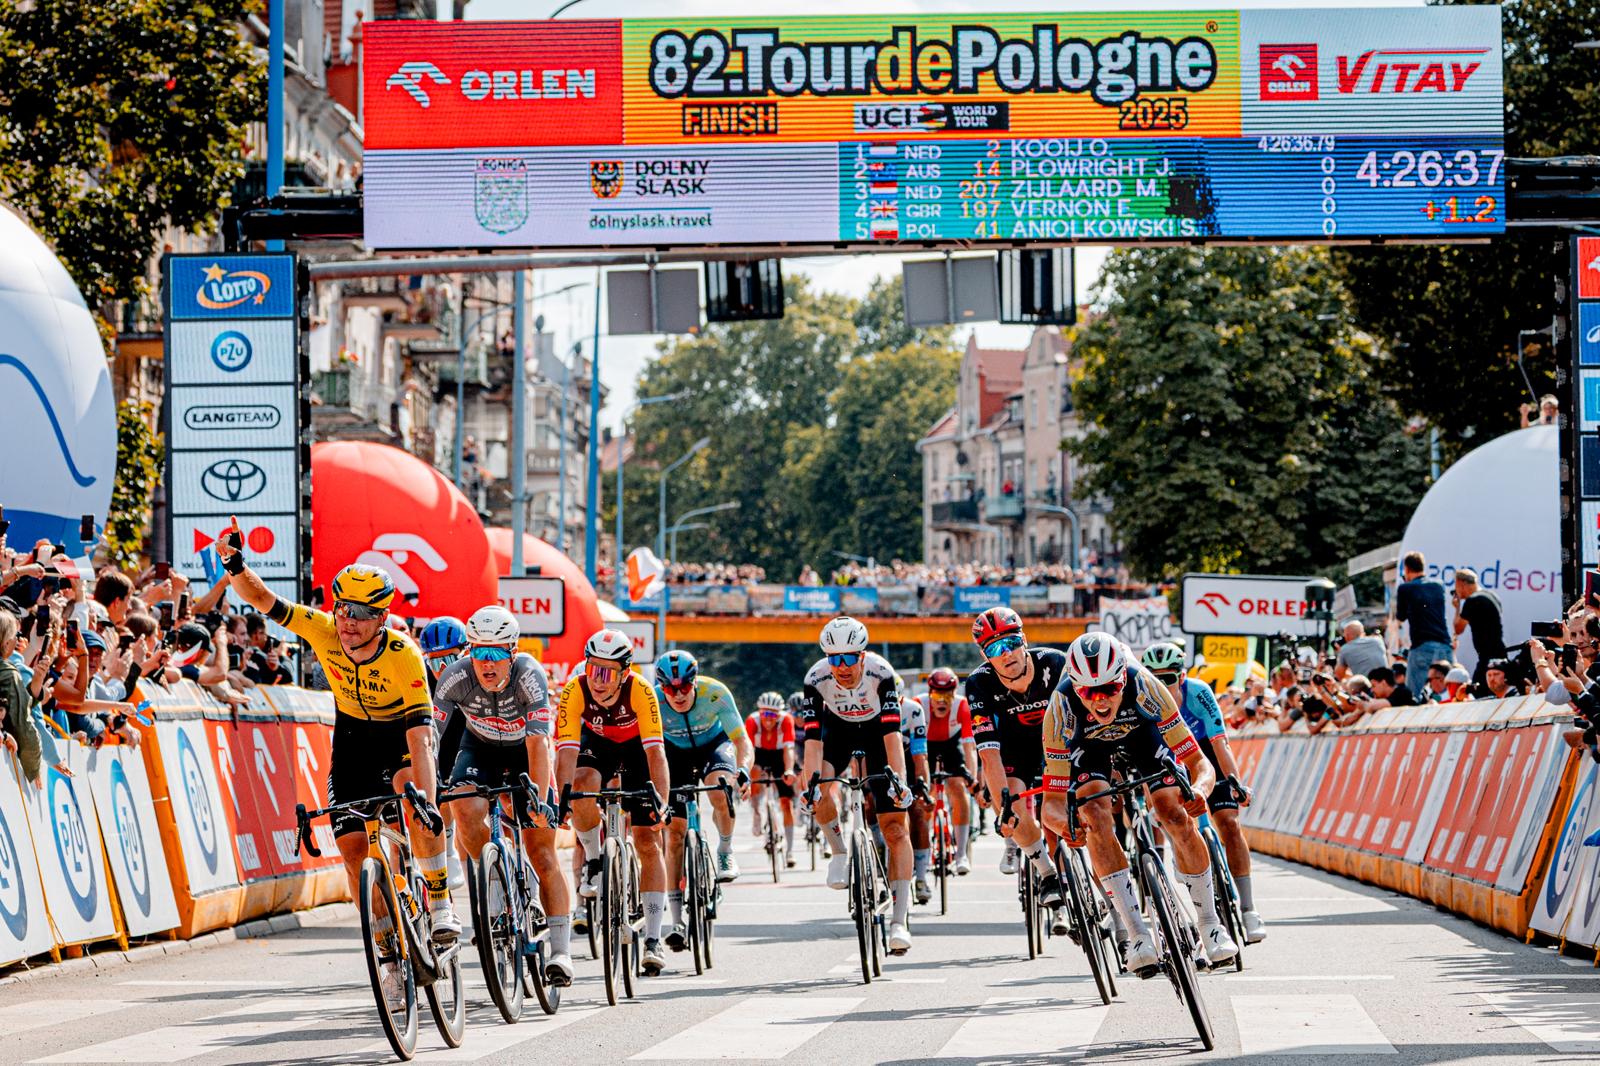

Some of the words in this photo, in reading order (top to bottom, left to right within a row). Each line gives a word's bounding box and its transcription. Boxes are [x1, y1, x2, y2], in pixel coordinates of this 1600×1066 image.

[1336, 50, 1481, 93] VITAY
[460, 69, 596, 99] ORLEN
[1267, 82, 1311, 93] ORLEN
[682, 103, 778, 135] FINISH
[952, 105, 998, 117] WORLD
[954, 115, 989, 128] TOUR
[1119, 98, 1188, 130] 2025
[855, 143, 864, 160] 1
[904, 145, 942, 160] NED
[986, 139, 1001, 157] 2
[1010, 138, 1083, 158] KOOIJ
[1089, 138, 1114, 158] O.
[636, 160, 711, 175] DOLNY
[854, 163, 868, 179] 2
[905, 164, 941, 179] AUS
[974, 160, 1001, 177] 14
[1010, 158, 1148, 177] PLOWRIGHT
[1155, 159, 1175, 177] J.
[1320, 156, 1335, 174] 0
[1356, 150, 1505, 188] 4:26:37
[854, 183, 869, 199] 3
[904, 184, 943, 199] NED
[958, 180, 1001, 199] 207
[1010, 178, 1122, 198] ZIJLAARD
[1135, 179, 1162, 197] M.
[1321, 176, 1336, 195] 0
[854, 203, 869, 219] 4
[905, 203, 943, 219] GBR
[960, 200, 1001, 218] 197
[1010, 199, 1111, 218] VERNON
[1321, 197, 1336, 214] 0
[1420, 196, 1497, 223] +1.2
[589, 213, 712, 230] dolnyslask.travel
[854, 223, 869, 239] 5
[905, 223, 943, 238] POL
[974, 220, 1000, 237] 41
[1322, 218, 1337, 235] 0
[219, 343, 244, 361] PZU
[1208, 643, 1246, 658] 25m
